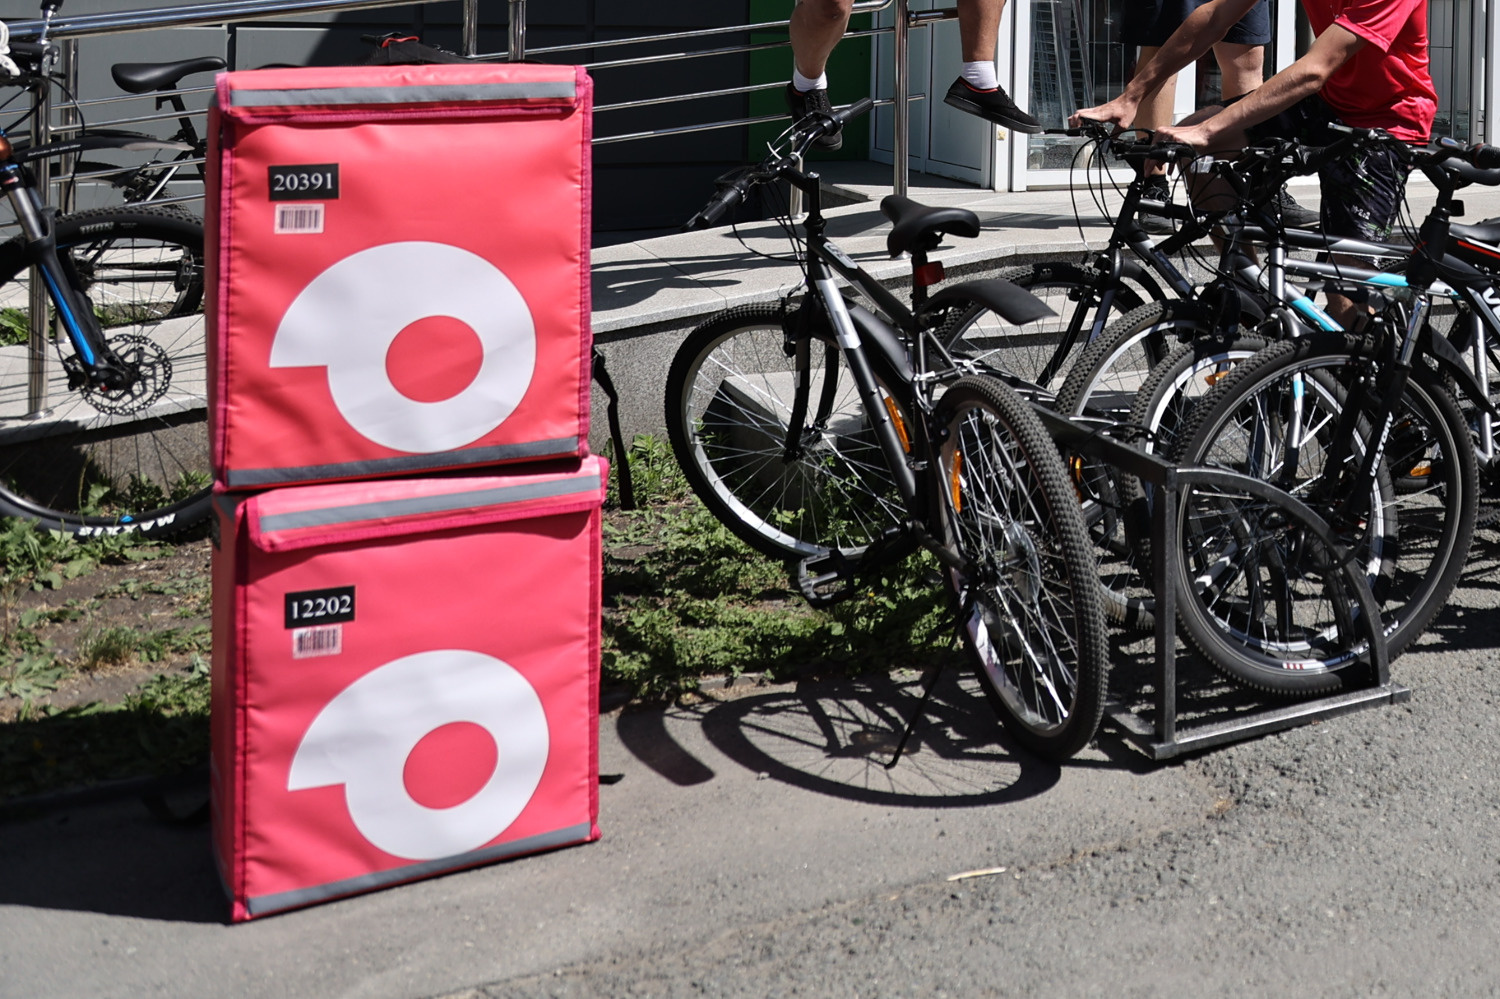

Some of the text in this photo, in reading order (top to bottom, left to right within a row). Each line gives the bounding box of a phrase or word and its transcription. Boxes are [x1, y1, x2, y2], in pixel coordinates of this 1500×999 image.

[273, 172, 333, 191] 20391
[1369, 411, 1394, 477] VELTORY
[291, 594, 352, 620] 12202
